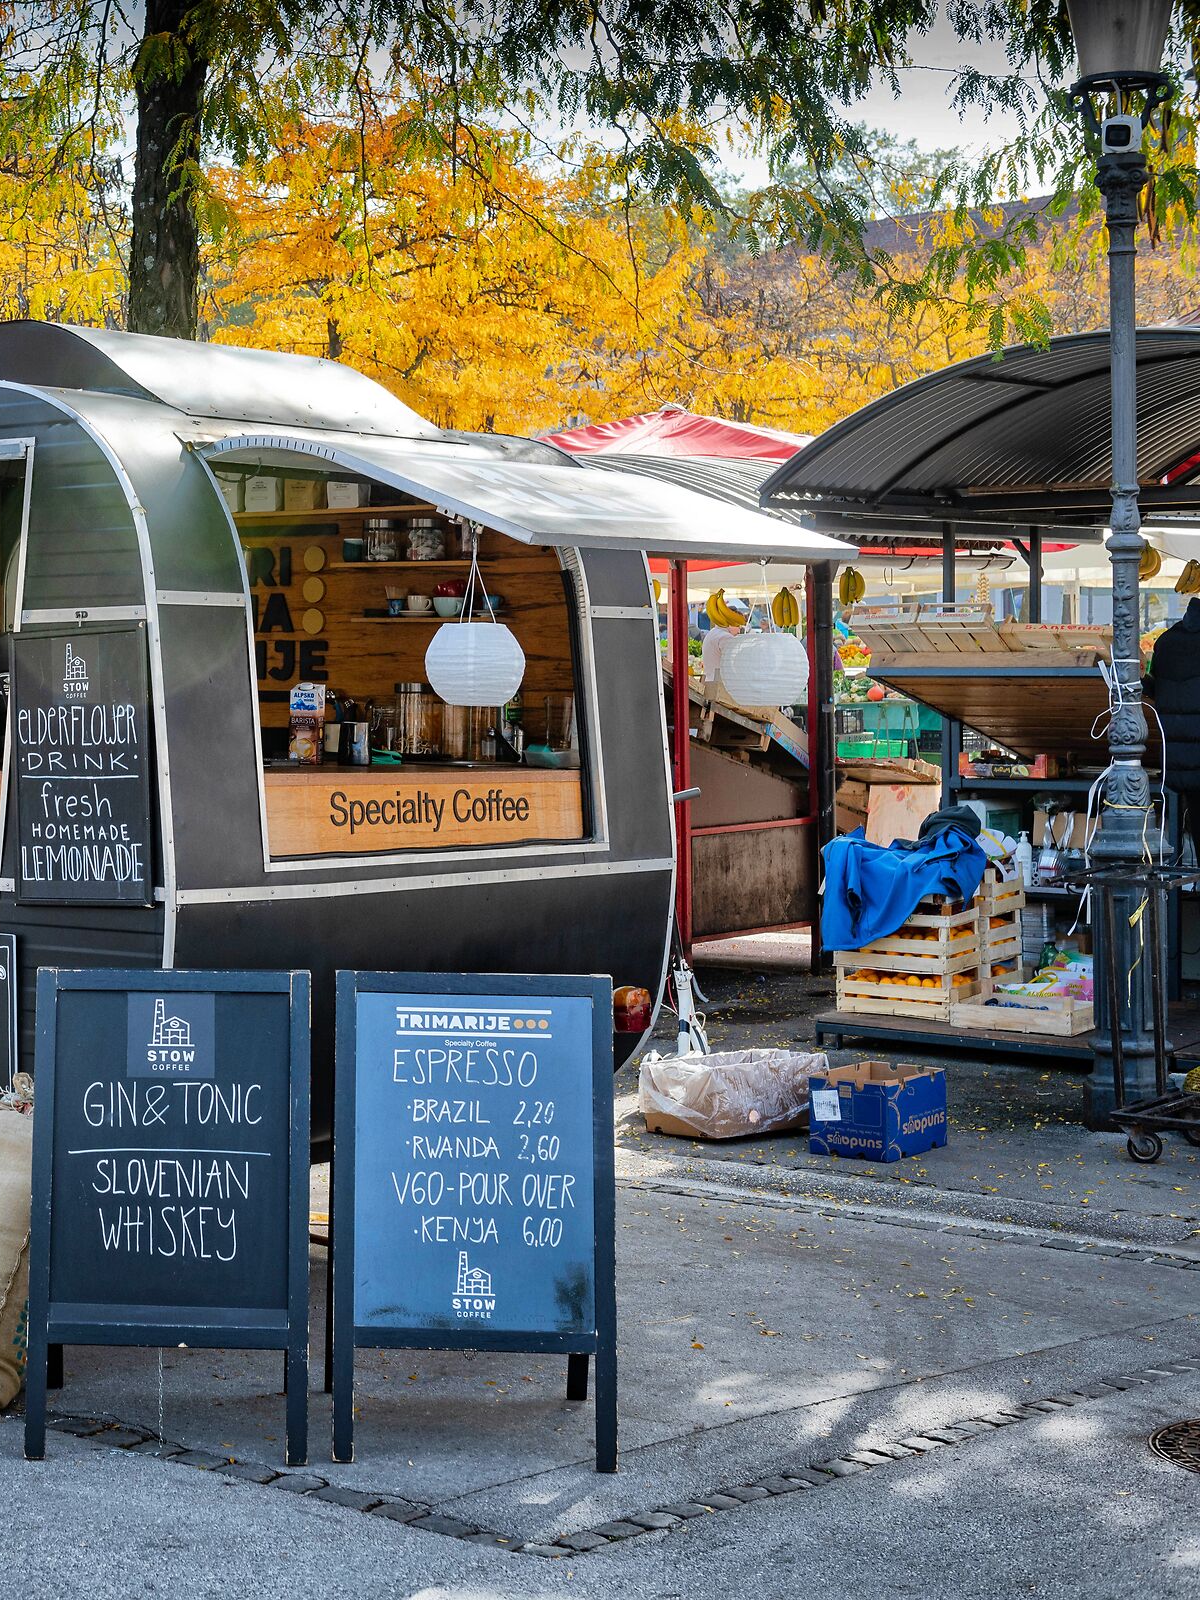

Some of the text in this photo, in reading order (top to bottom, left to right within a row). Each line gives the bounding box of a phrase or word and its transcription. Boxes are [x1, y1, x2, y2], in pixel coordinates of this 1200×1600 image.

[249, 547, 292, 587] RI
[255, 640, 329, 681] IJE
[63, 682, 89, 692] STOW
[290, 717, 316, 725] BARISTA
[27, 752, 129, 771] DRINK
[40, 782, 113, 818] fresh
[330, 789, 530, 835] Specialty Coffee
[31, 823, 130, 841] HOMEMADE
[21, 843, 144, 882] LEMONADE
[396, 1013, 512, 1031] TRIMARIJE
[147, 1050, 195, 1062] STOW
[444, 1039, 497, 1048] Specialty Coffee
[393, 1049, 538, 1087] ESPRESSO
[172, 1082, 263, 1125] TONIC
[412, 1100, 555, 1128] BRAZIL 2,20
[412, 1135, 560, 1163] RWANDA 2,60
[92, 1159, 249, 1199] SLOVENIAN
[522, 1173, 576, 1209] OVER
[99, 1206, 237, 1262] WHISKEY
[421, 1215, 563, 1248] KENYA 6,00
[452, 1298, 496, 1311] STOW
[456, 1311, 491, 1319] COFFEE
